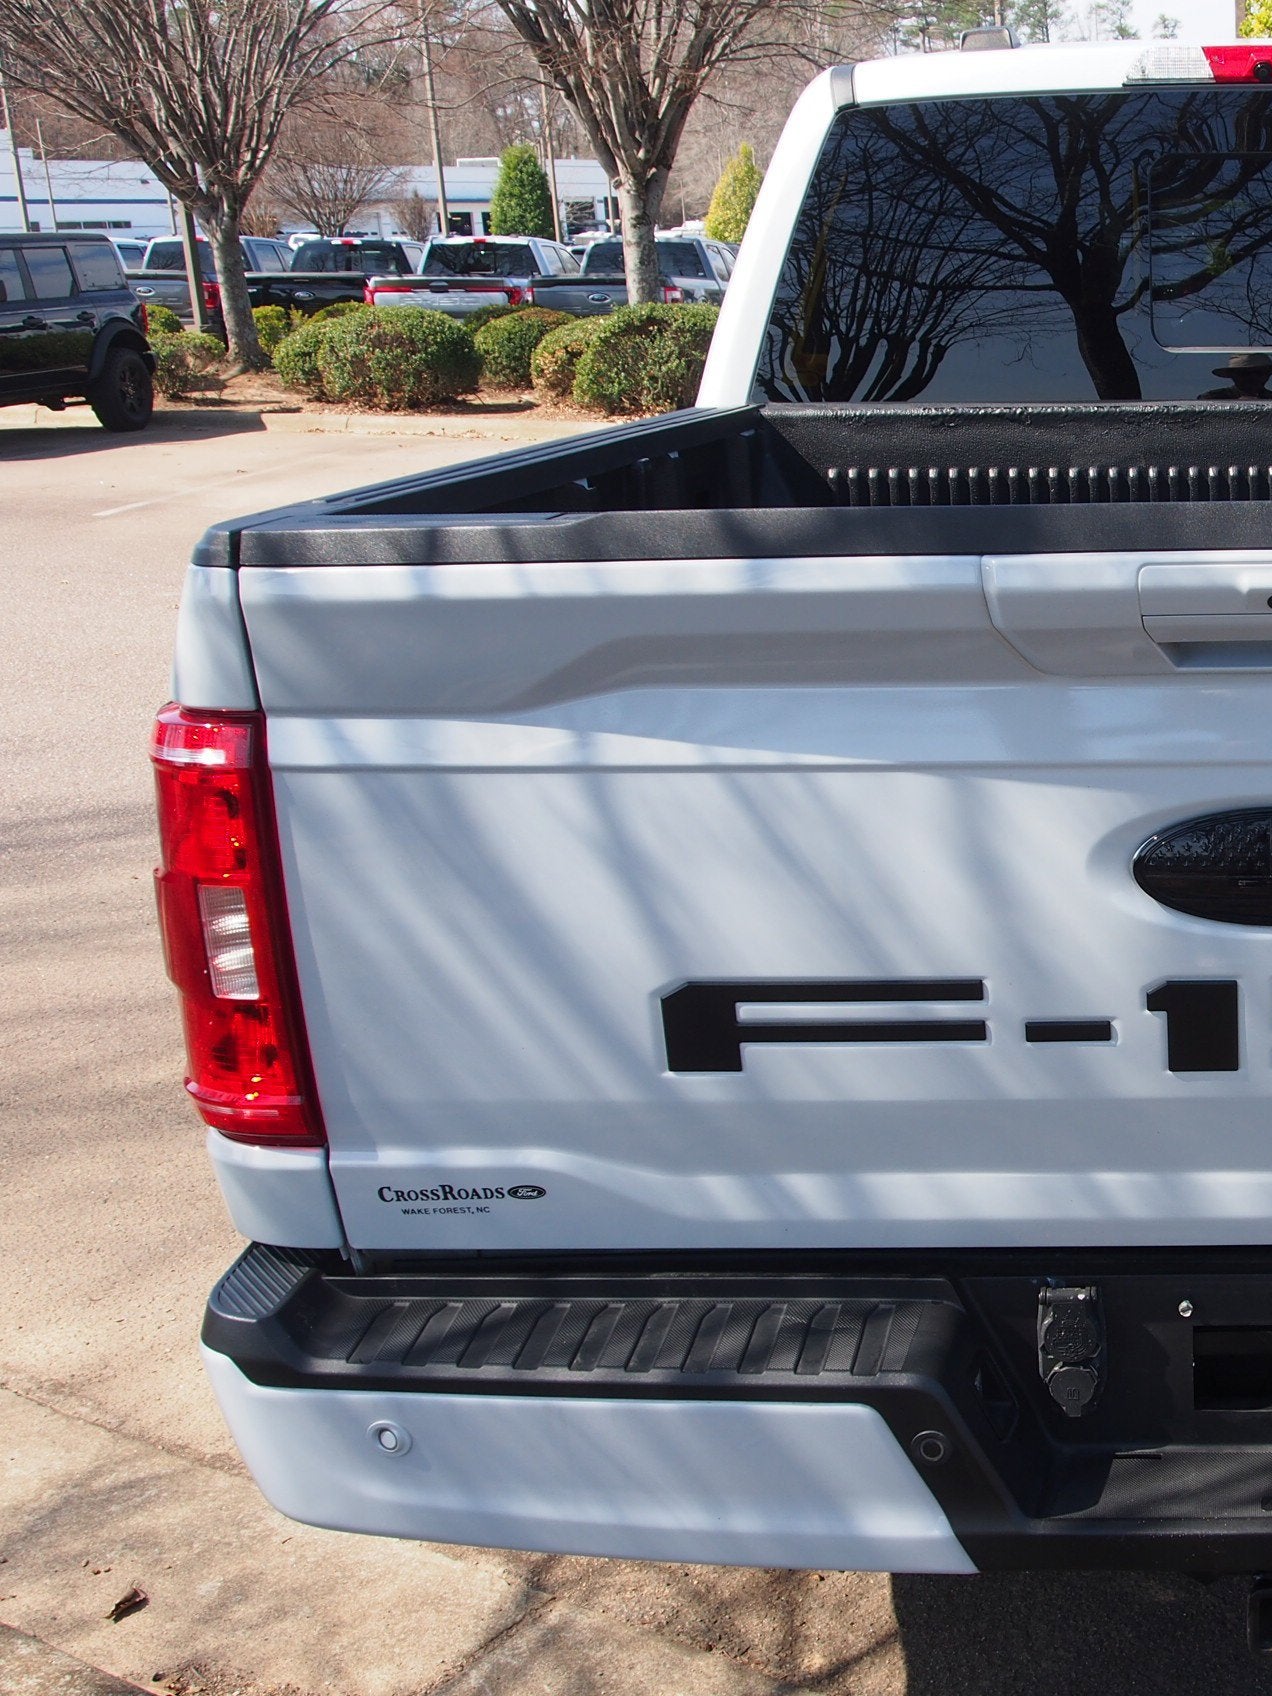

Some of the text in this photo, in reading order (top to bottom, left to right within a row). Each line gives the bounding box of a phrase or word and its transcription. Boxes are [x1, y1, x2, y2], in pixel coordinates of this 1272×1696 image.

[401, 1206, 490, 1215] WAKE FOREST, NC
